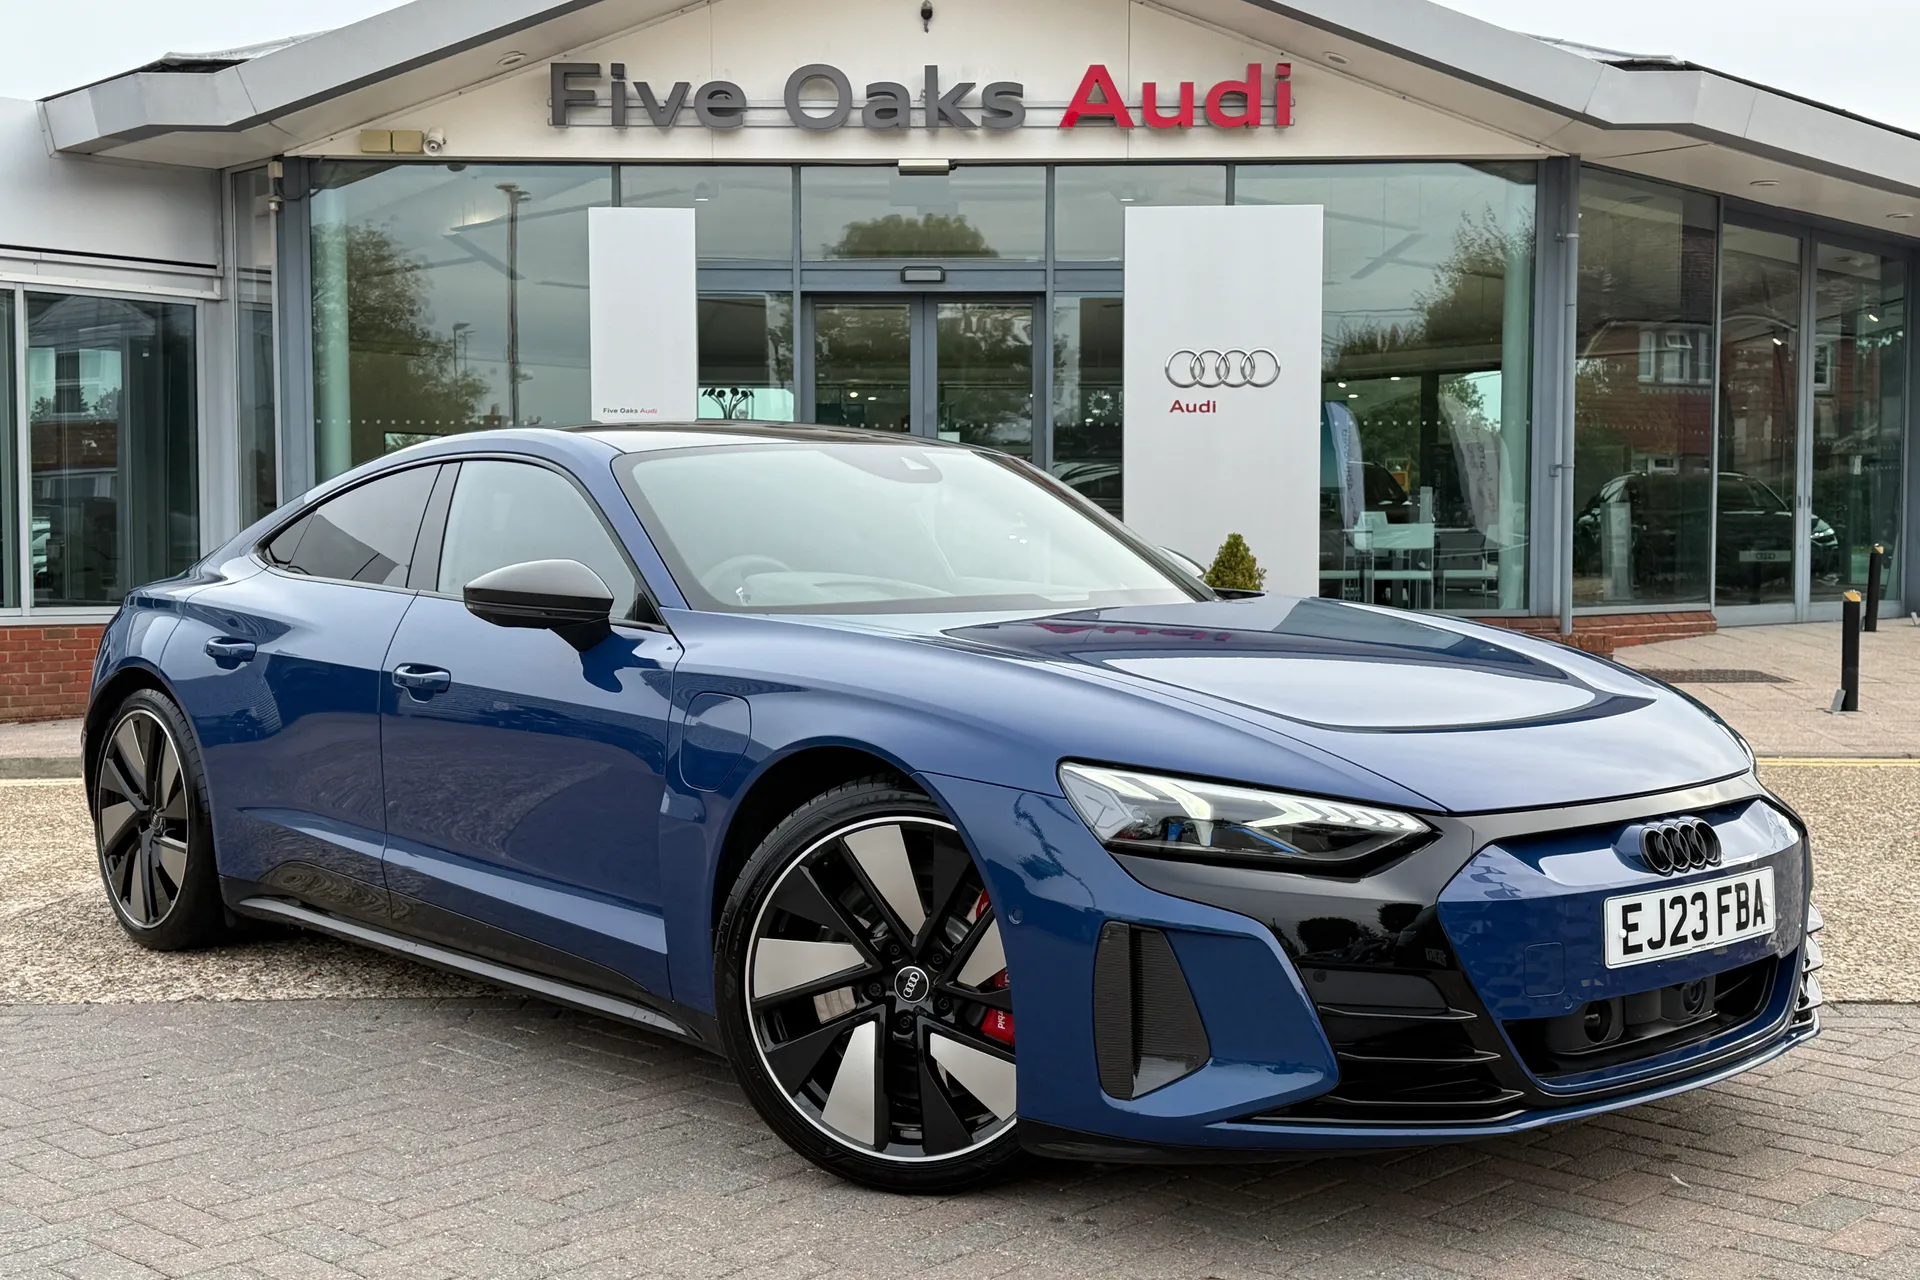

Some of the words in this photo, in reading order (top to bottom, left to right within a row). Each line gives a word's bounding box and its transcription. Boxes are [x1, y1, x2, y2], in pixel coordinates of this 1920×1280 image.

[549, 62, 747, 129] Five
[784, 62, 1026, 130] Oaks
[1058, 62, 1292, 129] Audi
[1169, 399, 1217, 413] Audi
[1621, 891, 1708, 956] EJ23
[1716, 878, 1766, 936] FBA
